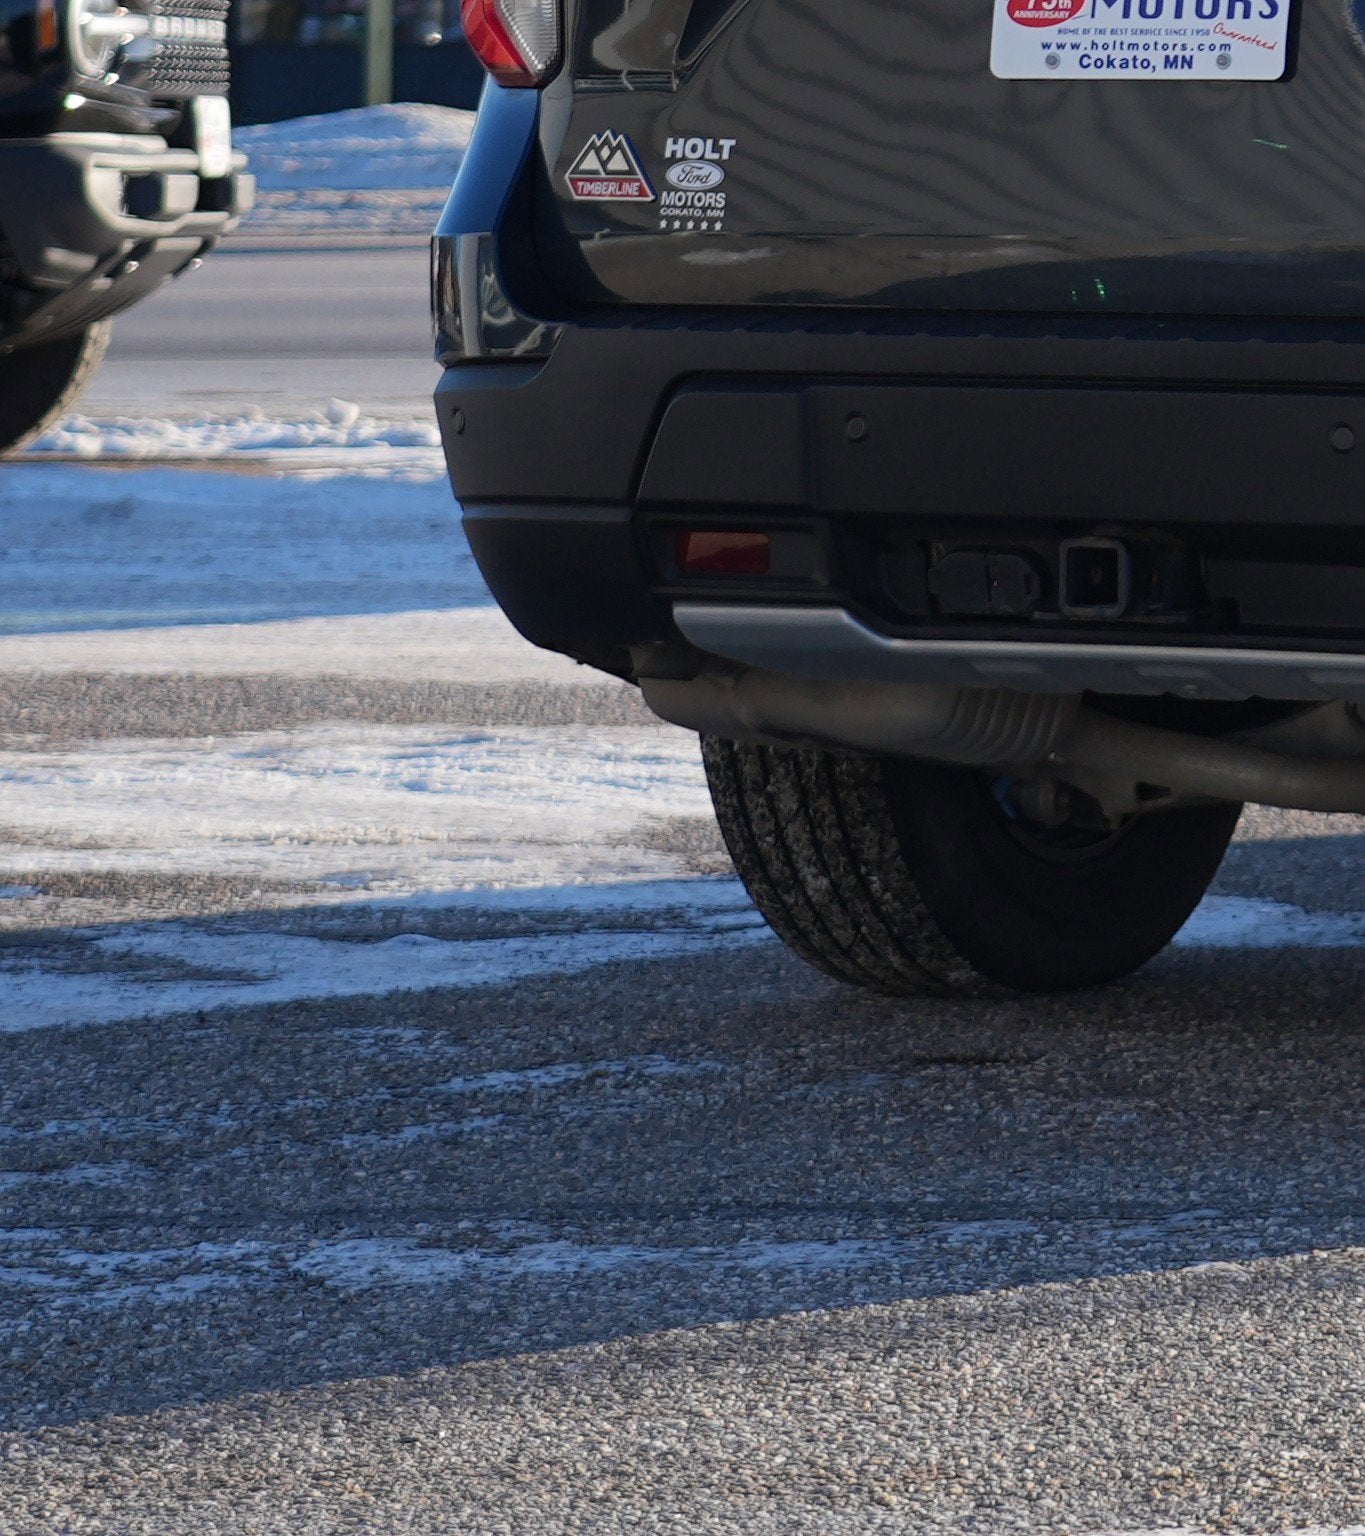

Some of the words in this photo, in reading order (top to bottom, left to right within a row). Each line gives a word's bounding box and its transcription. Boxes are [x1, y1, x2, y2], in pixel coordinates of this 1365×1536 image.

[1013, 9, 1071, 19] ANNIVERSARY
[1057, 27, 1080, 36] HOME
[1082, 27, 1091, 36] OF
[1093, 27, 1107, 36] THE
[1110, 27, 1129, 36] BEST
[1164, 27, 1187, 36] SINCE
[1213, 22, 1279, 51] Guaranteed
[1041, 39, 1232, 52] www.holtmotors.com
[1079, 53, 1157, 73] Cokato,
[1164, 54, 1194, 70] MN
[664, 137, 737, 161] HOLT
[673, 164, 714, 186] Ford
[576, 181, 641, 196] TIMBERLINE
[660, 190, 727, 208] MOTORS
[659, 207, 704, 218] COKATO,
[706, 208, 725, 218] MN
